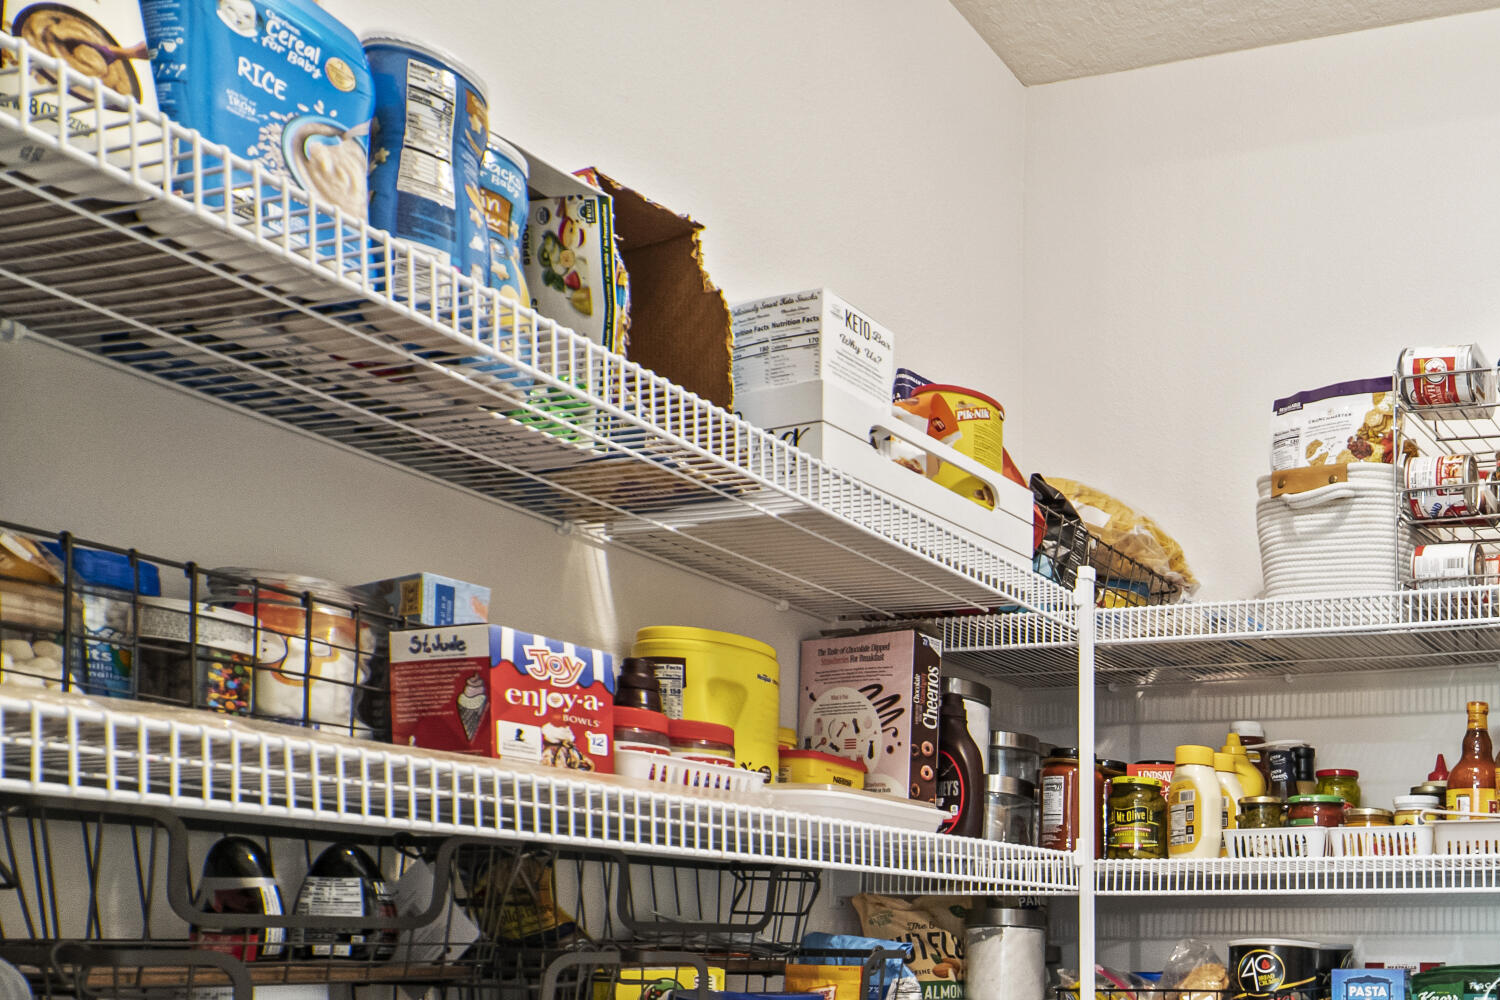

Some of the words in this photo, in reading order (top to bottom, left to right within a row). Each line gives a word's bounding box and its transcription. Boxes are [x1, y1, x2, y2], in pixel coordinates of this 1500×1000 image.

[261, 35, 286, 53] for
[265, 19, 322, 65] Cereal
[237, 55, 288, 101] RICE
[770, 316, 801, 330] Nutrition
[802, 314, 820, 327] Facts
[844, 308, 872, 341] KETO
[956, 407, 991, 421] Pik-Nik
[922, 665, 939, 730] Cheerios
[562, 713, 600, 729] BOWLS
[1126, 809, 1146, 822] Olive
[1240, 954, 1276, 992] 4C
[1349, 985, 1388, 998] PASTA
